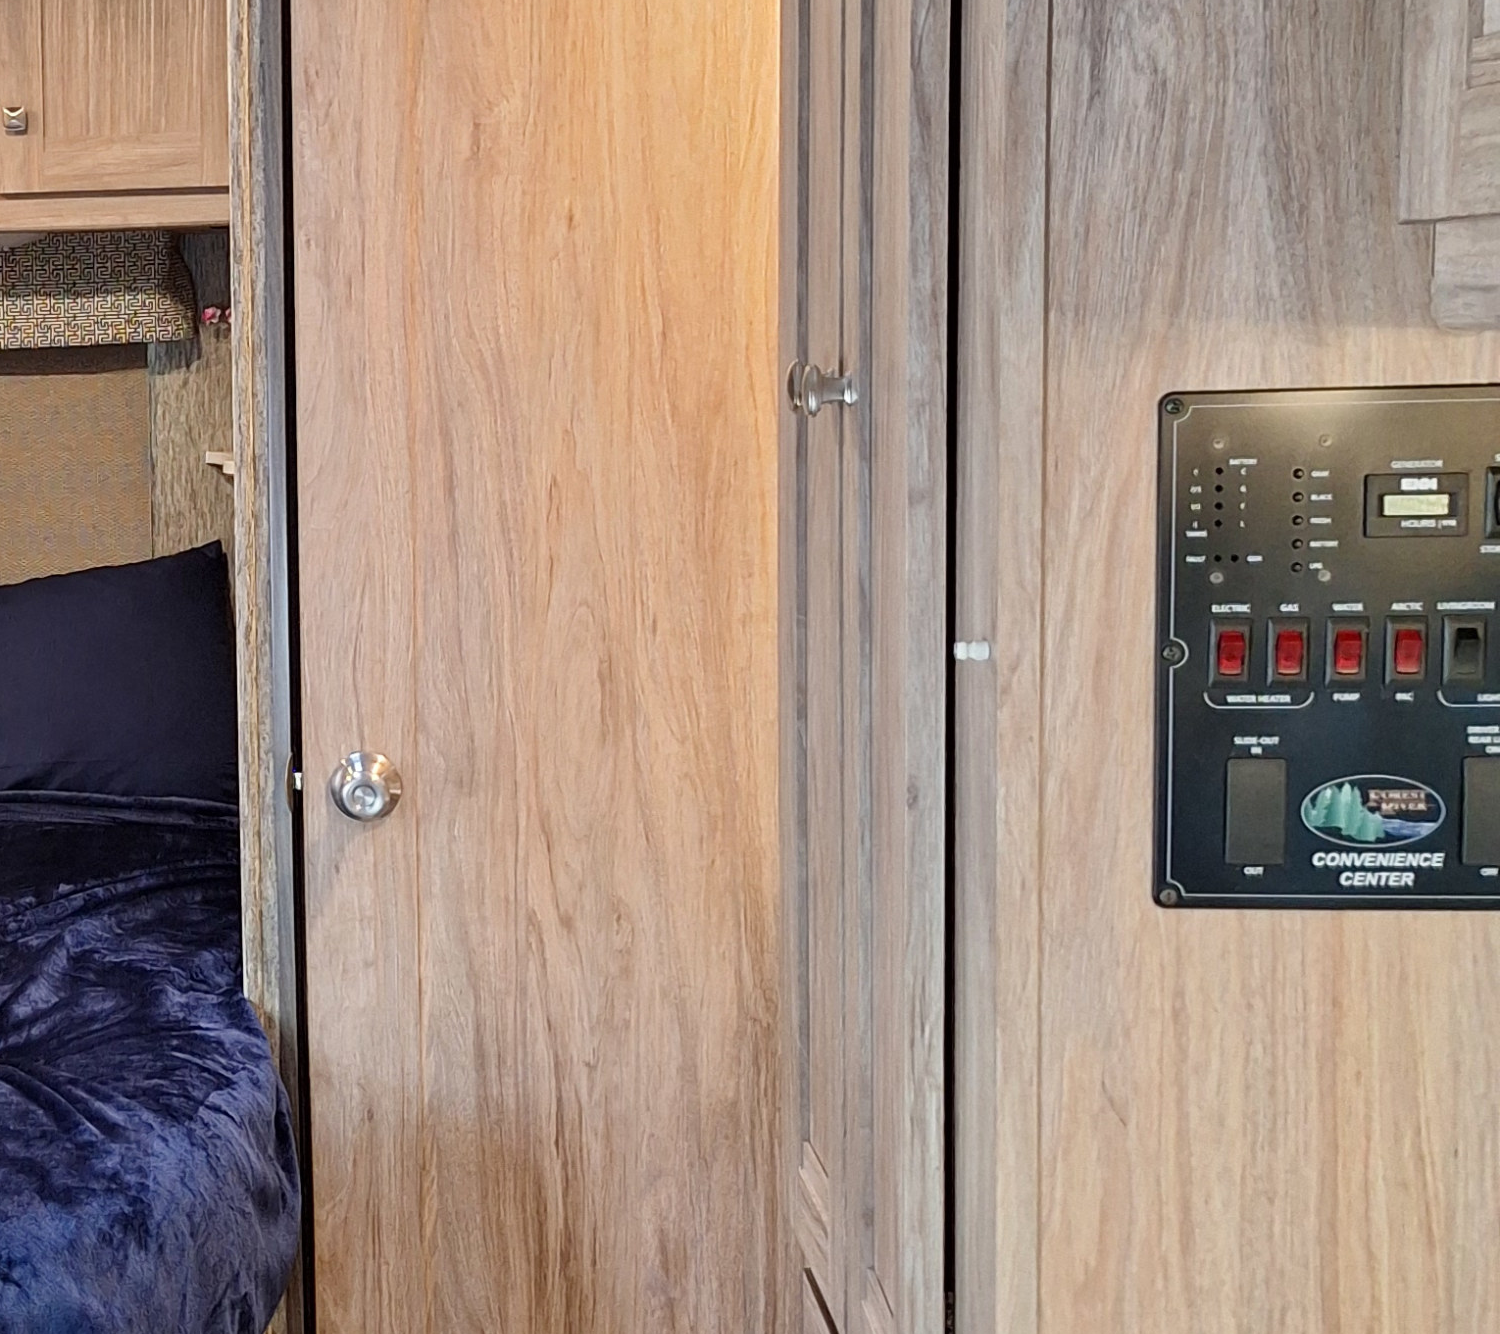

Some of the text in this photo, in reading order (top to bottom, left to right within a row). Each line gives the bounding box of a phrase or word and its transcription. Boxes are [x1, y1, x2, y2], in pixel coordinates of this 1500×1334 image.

[1279, 603, 1300, 613] GAS
[1312, 852, 1445, 868] CONVENIENCE
[1339, 871, 1415, 887] CENTER
